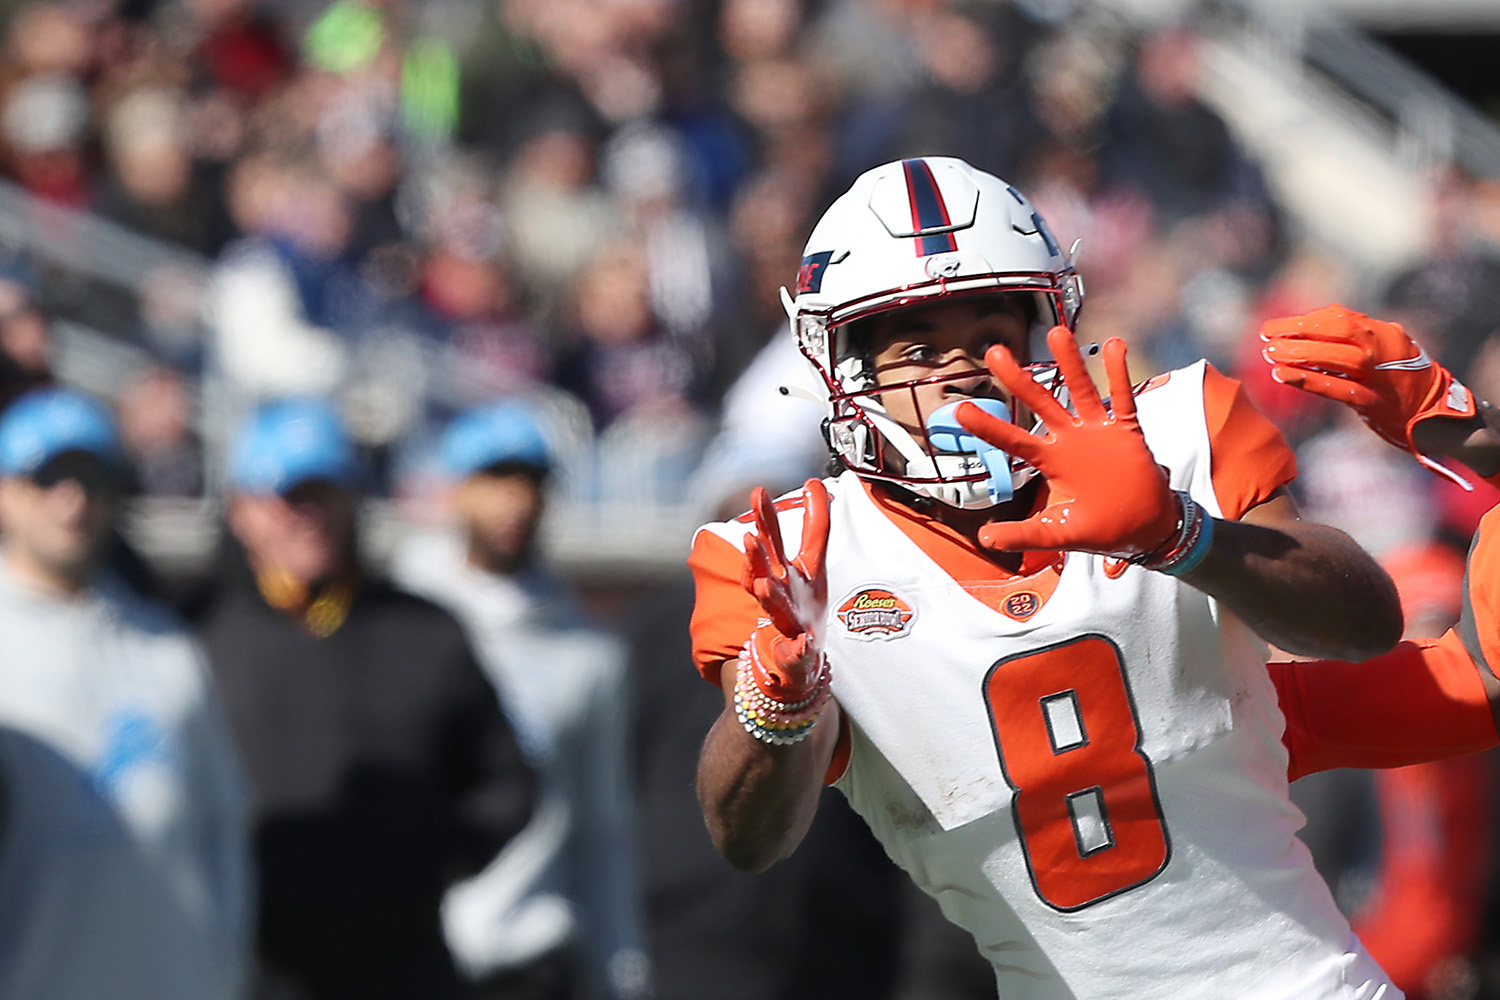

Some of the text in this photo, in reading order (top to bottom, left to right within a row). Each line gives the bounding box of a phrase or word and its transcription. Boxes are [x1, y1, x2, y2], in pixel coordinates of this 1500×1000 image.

[1010, 594, 1031, 605] 20
[1012, 603, 1033, 615] 22
[982, 632, 1172, 913] 8
